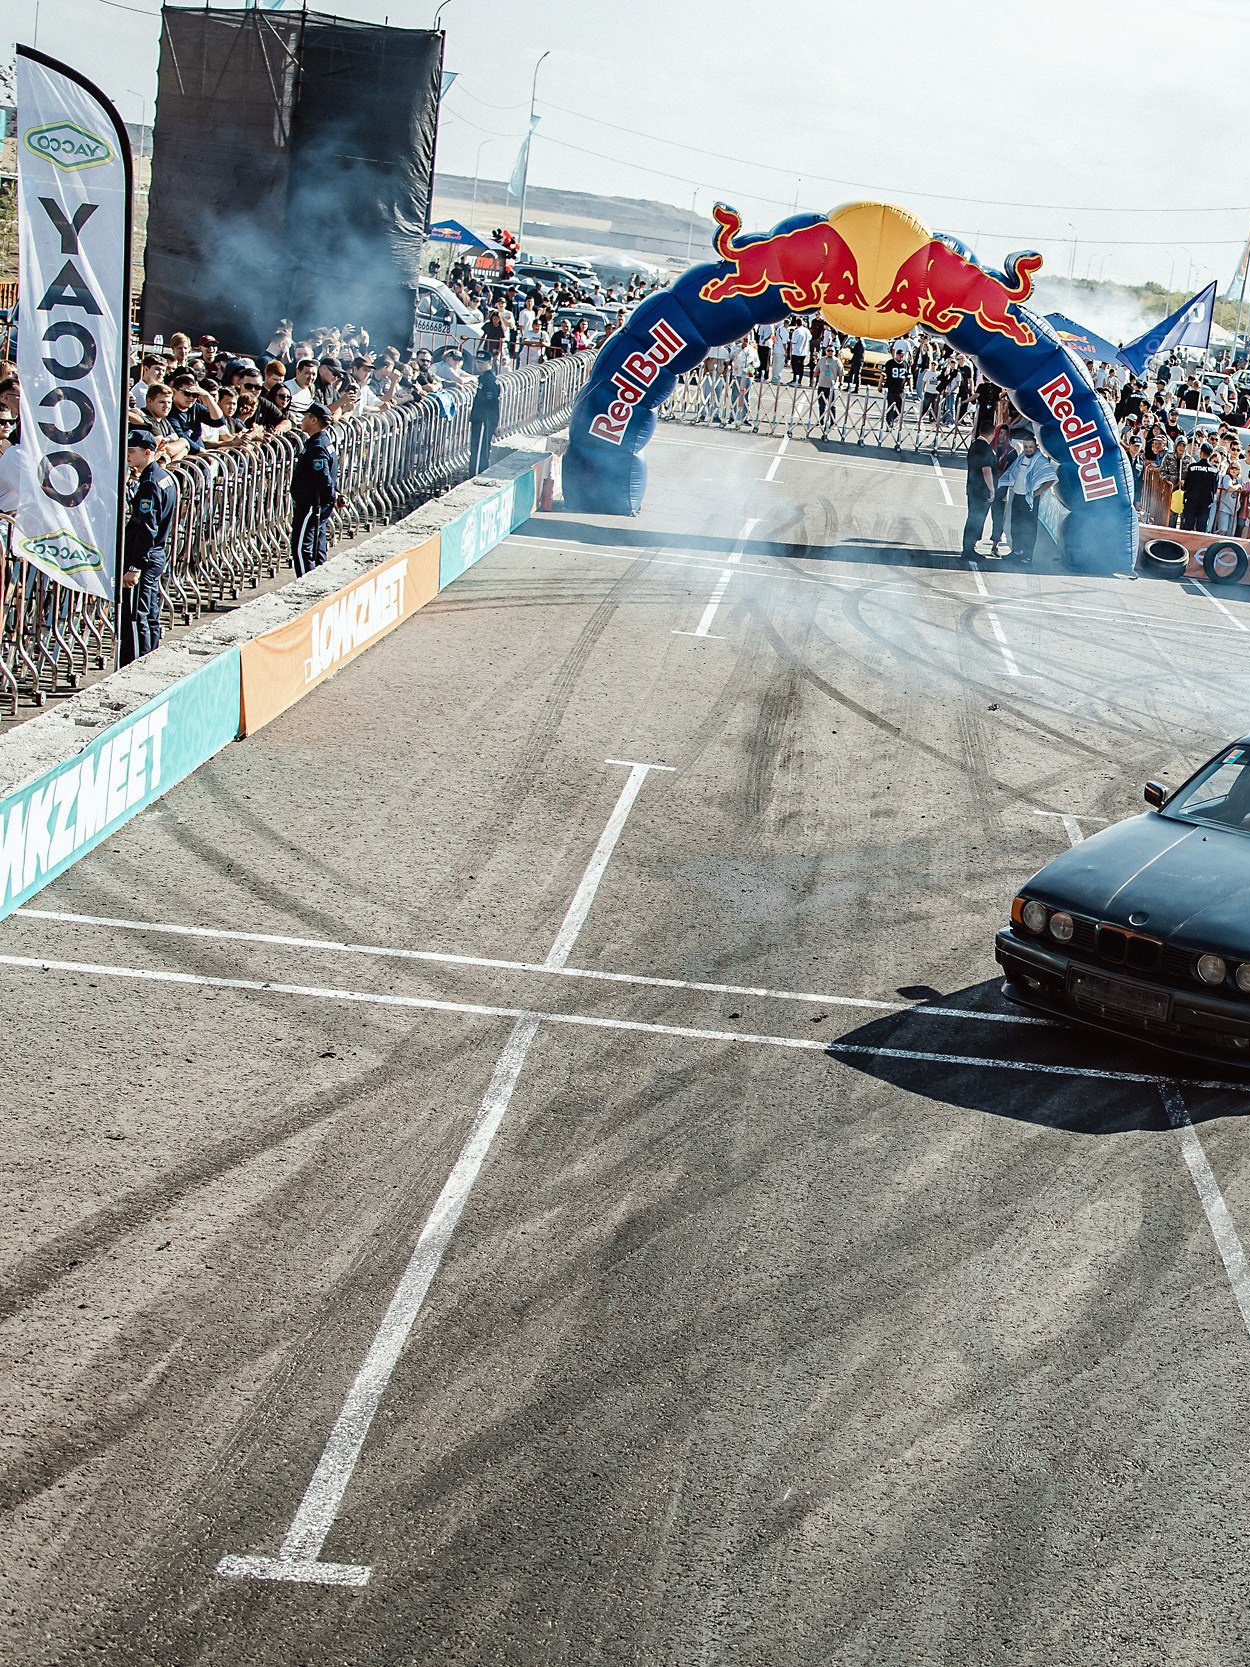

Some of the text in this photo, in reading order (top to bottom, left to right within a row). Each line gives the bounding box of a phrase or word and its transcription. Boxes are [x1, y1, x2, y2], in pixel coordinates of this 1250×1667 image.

[589, 318, 688, 446] Red Bull
[892, 367, 907, 379] 92
[1037, 372, 1118, 502] Red Bull
[0, 699, 170, 906] WKZMEET
